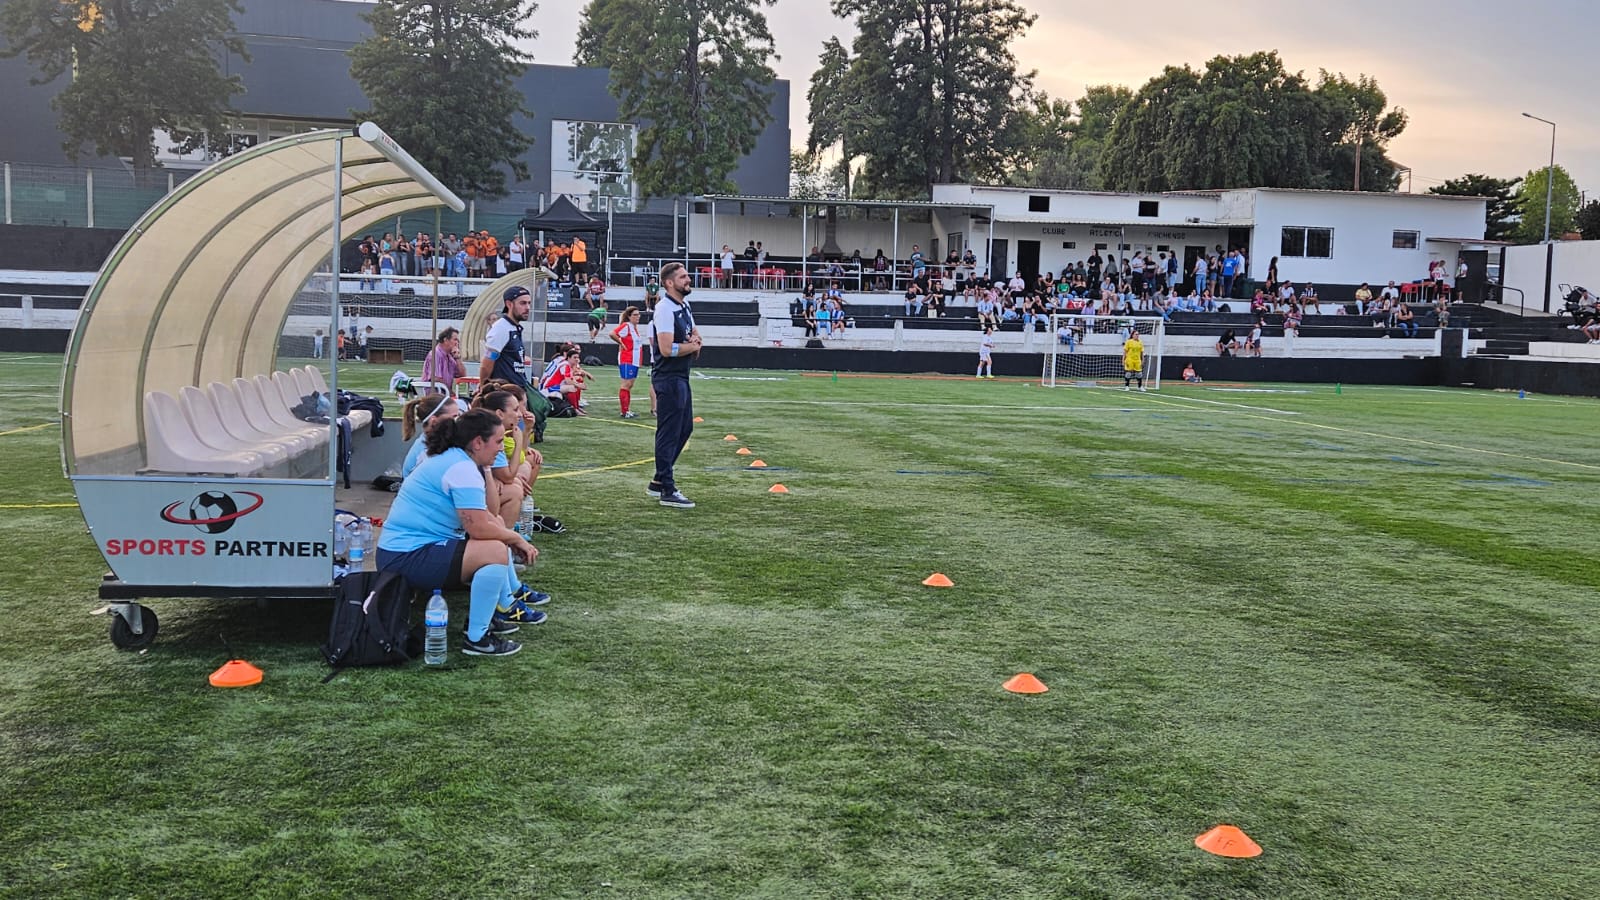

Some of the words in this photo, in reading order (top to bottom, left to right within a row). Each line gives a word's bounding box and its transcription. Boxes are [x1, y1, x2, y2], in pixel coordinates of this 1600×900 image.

[1042, 227, 1066, 235] CLUBE
[106, 539, 206, 556] SPORTS
[214, 540, 328, 557] PARTNER
